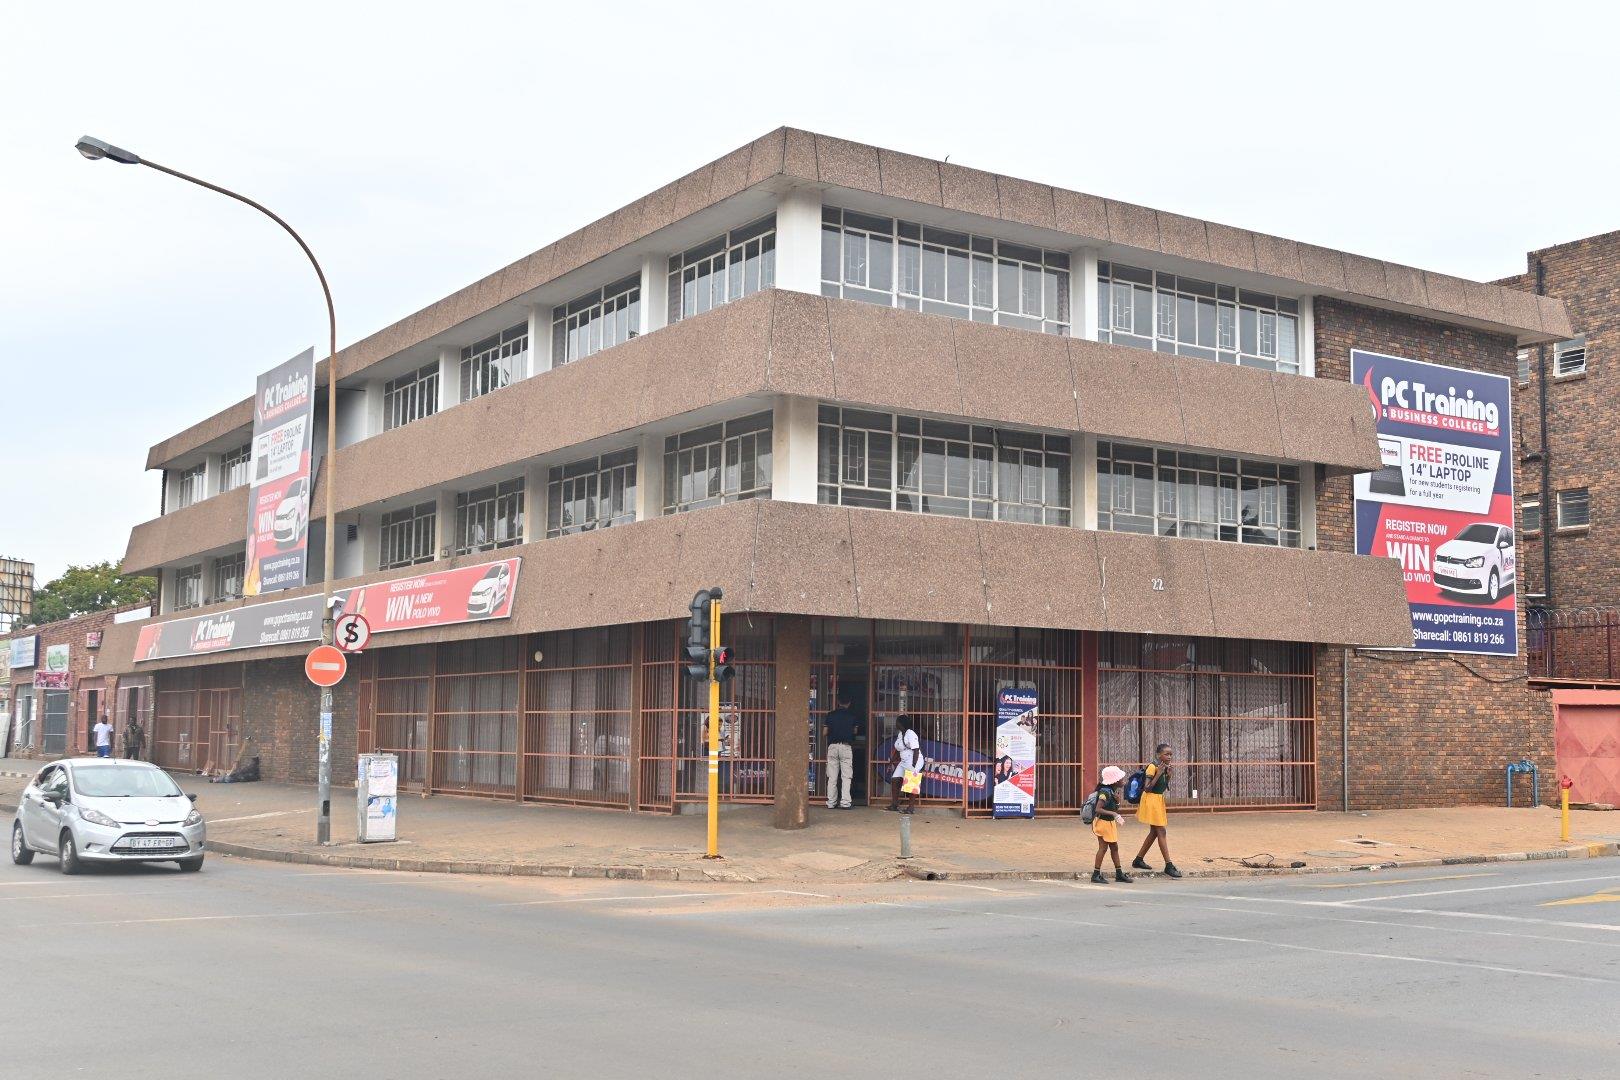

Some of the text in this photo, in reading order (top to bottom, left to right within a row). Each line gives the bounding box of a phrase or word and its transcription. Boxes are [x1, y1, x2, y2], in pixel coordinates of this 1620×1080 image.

[264, 372, 308, 410] PC Training
[1381, 376, 1499, 430] PC Training
[1382, 408, 1484, 432] & BUSINESS COLLEGE
[1409, 443, 1489, 470] FREE PROLINE
[1410, 463, 1471, 482] 14" LAPTOP
[1409, 477, 1417, 485] for
[1430, 481, 1453, 490] students
[1453, 483, 1481, 495] registering
[1409, 487, 1418, 496] for
[1422, 489, 1432, 498] full
[1432, 492, 1444, 500] year
[259, 510, 274, 533] WIN
[1386, 519, 1447, 535] REGISTER NOW
[1386, 541, 1430, 571] WIN
[390, 580, 413, 592] REGISTER
[413, 578, 426, 590] NOW
[1151, 578, 1165, 590] 22
[1403, 572, 1431, 583] LO VIVO
[385, 594, 415, 622] WIN
[420, 592, 434, 604] NEW
[412, 608, 427, 620] POLO
[263, 610, 313, 627] www.gopctraining.co.za
[1412, 611, 1504, 627] www.gopctraining.co.za
[195, 614, 235, 642] PC Training
[1413, 628, 1505, 645] Sharecall: 0861 819 266
[1013, 695, 1037, 704] Training
[924, 757, 987, 786] Trainng
[941, 775, 973, 786] COLLEE
